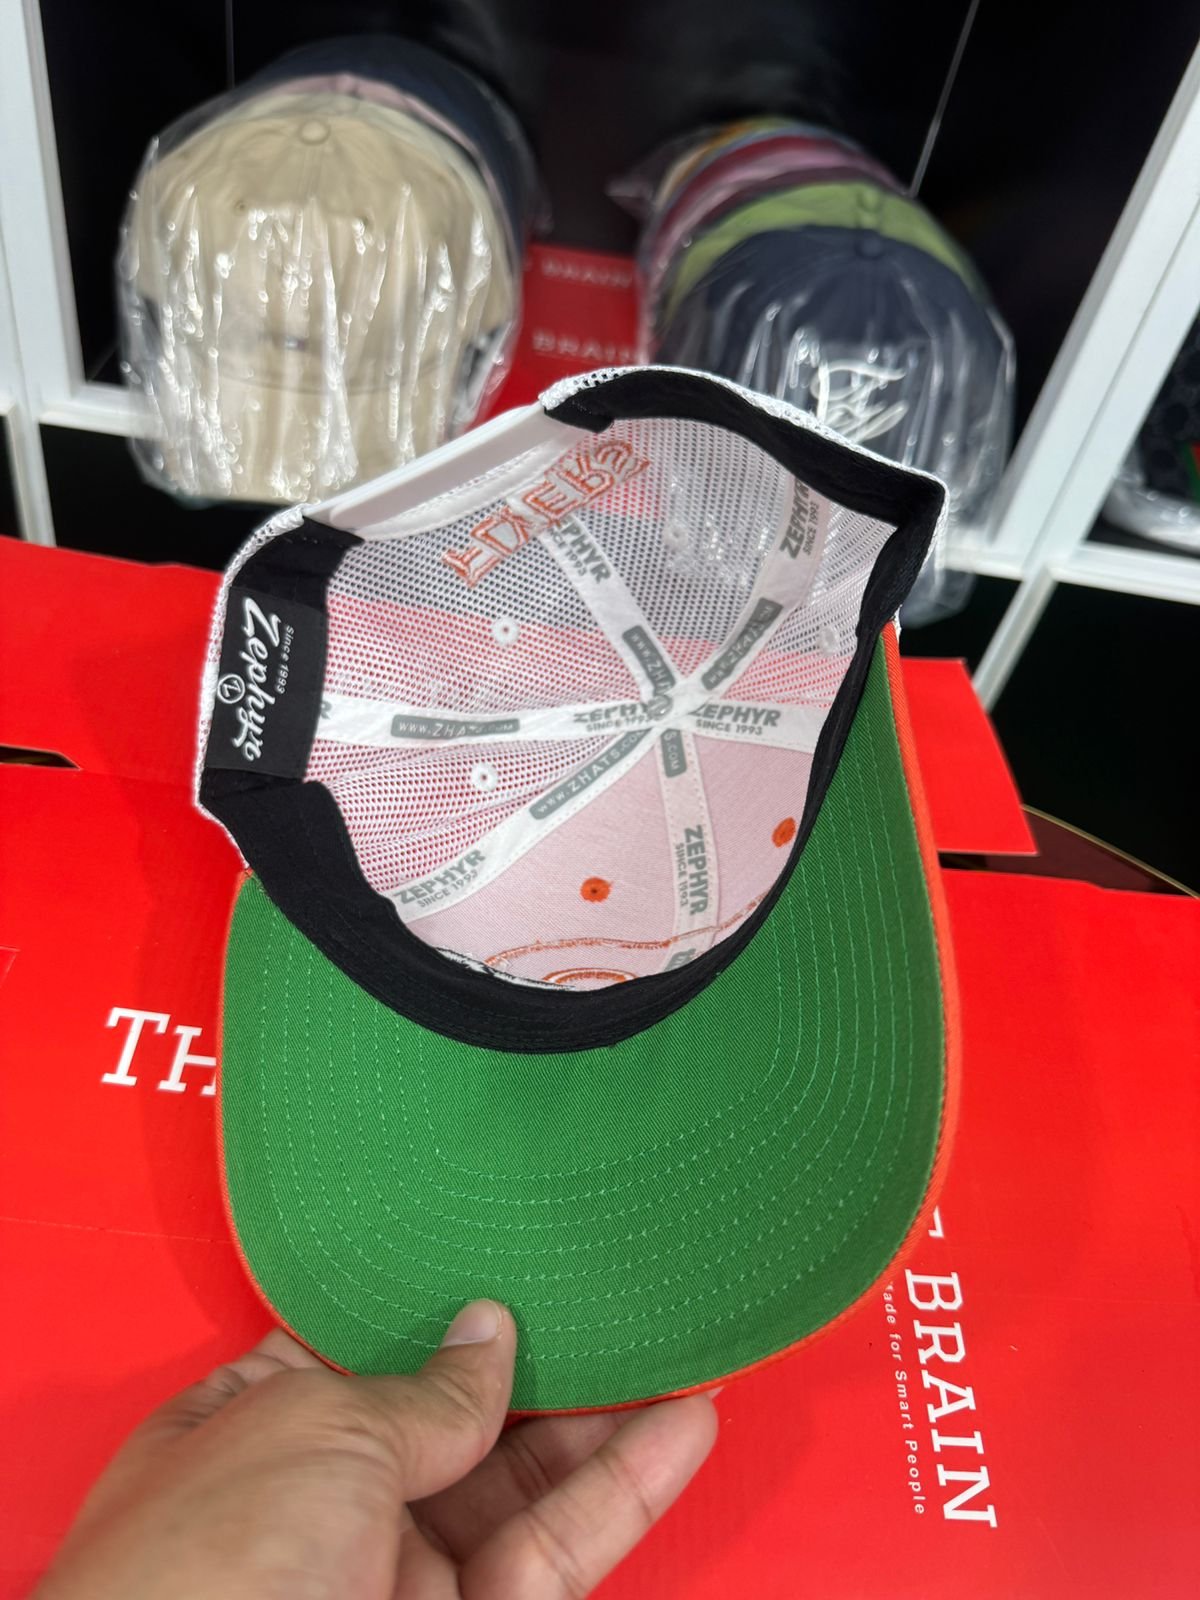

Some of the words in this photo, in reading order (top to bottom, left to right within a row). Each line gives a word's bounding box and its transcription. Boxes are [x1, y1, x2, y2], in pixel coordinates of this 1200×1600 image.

[231, 597, 282, 762] Zephyr
[274, 662, 290, 695] 1993
[688, 703, 781, 728] ZEPHYR
[695, 719, 731, 732] SINCE
[735, 723, 764, 736] 1993
[393, 849, 487, 905] ZEPHYR
[674, 842, 688, 879] SINCE
[684, 824, 708, 916] ZEPHYR
[417, 886, 452, 909] SINCE
[450, 868, 479, 891] 1993
[678, 880, 690, 907] 1993
[888, 1332, 903, 1362] for
[894, 1369, 915, 1430] Smart
[904, 1268, 998, 1529] BRAIN
[904, 1439, 926, 1515] People
